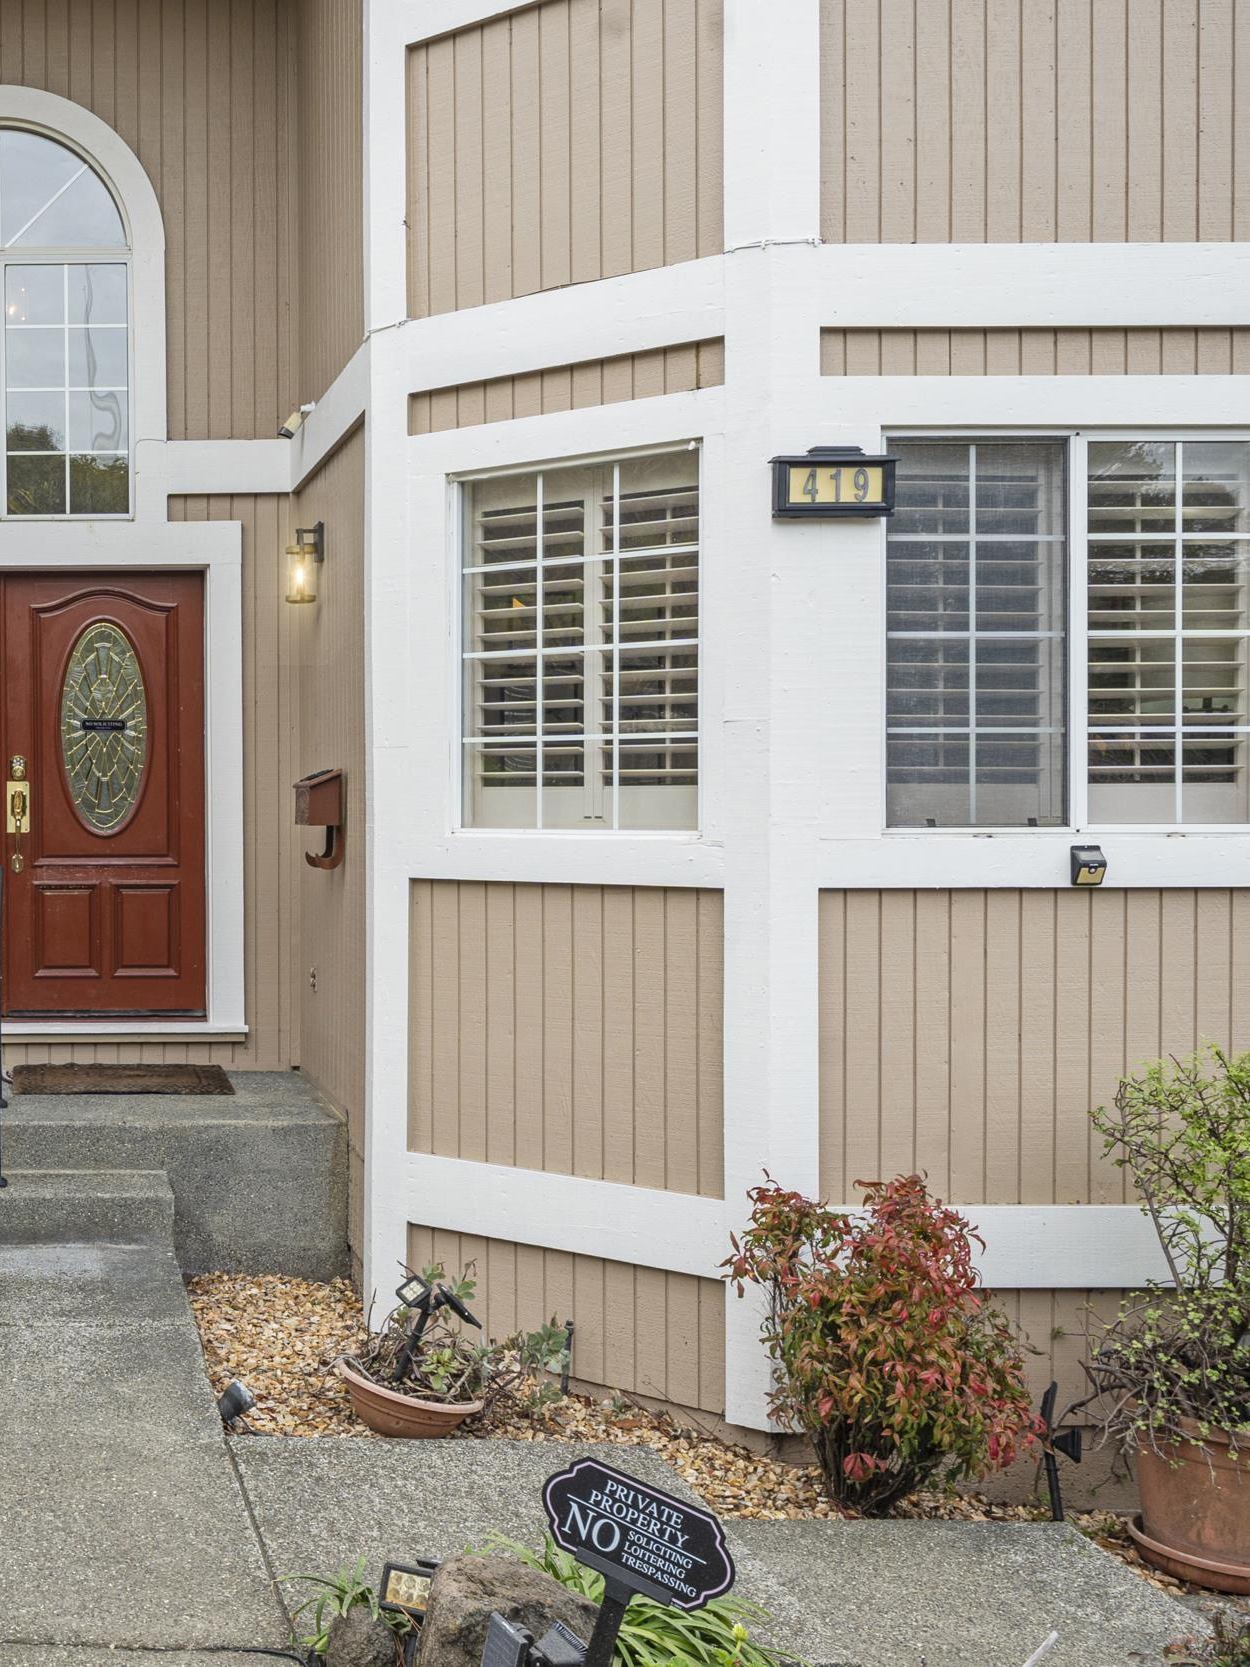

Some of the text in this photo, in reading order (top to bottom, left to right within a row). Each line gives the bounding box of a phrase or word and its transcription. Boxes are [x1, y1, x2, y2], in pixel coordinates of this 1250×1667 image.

[802, 467, 869, 503] 419
[588, 1489, 690, 1549] PROPERTY
[604, 1479, 684, 1529] PRIVATE
[561, 1501, 621, 1552] NO
[623, 1541, 686, 1579] LOITERING
[627, 1530, 693, 1570] SOLICITING
[621, 1553, 697, 1597] TRESPASSING
